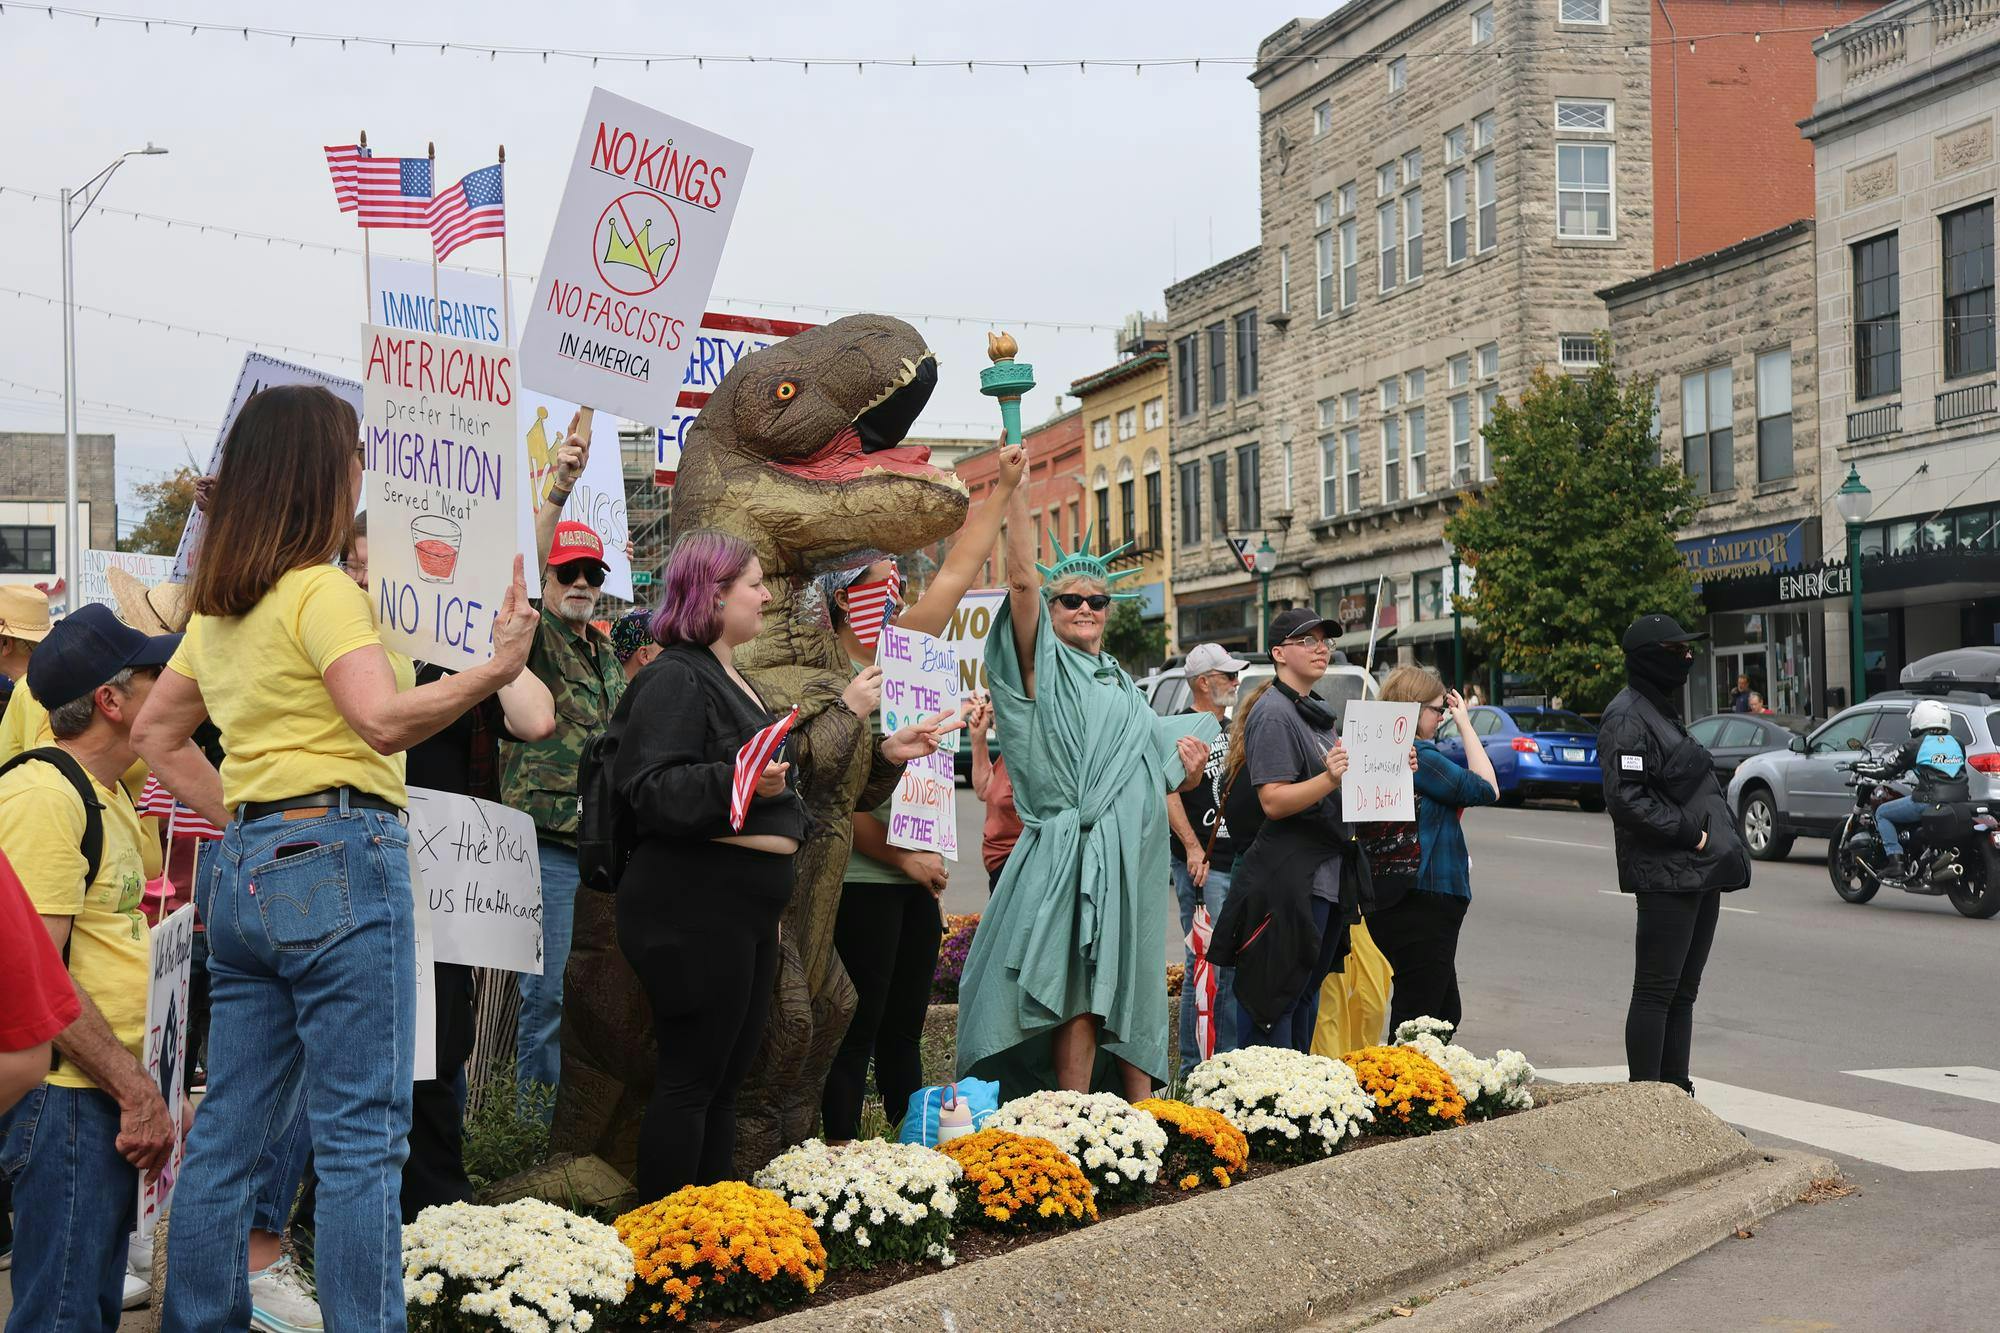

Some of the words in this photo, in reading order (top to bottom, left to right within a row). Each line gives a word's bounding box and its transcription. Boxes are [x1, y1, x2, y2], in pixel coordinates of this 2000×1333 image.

[591, 122, 637, 175] NO
[382, 290, 500, 342] IMMIGRANTS
[547, 279, 582, 318] NO
[583, 292, 685, 351] FASCISTS
[366, 333, 512, 406] AMERICANS
[559, 332, 580, 357] IN
[579, 339, 650, 381] AMERICA
[449, 403, 491, 437] their
[384, 481, 429, 511] Served
[559, 530, 600, 552] MARINES
[1707, 532, 1789, 565] EMPTOR
[1779, 567, 1852, 601] ENRICH
[380, 577, 419, 635] NO
[947, 606, 990, 641] NO
[884, 627, 912, 662] THE
[920, 635, 959, 696] Beauty
[886, 679, 905, 705] OF
[911, 684, 941, 712] THE
[1357, 785, 1368, 812] Do
[892, 813, 910, 838] OF
[909, 816, 935, 844] THE
[451, 821, 491, 865] the
[496, 825, 534, 878] Rich
